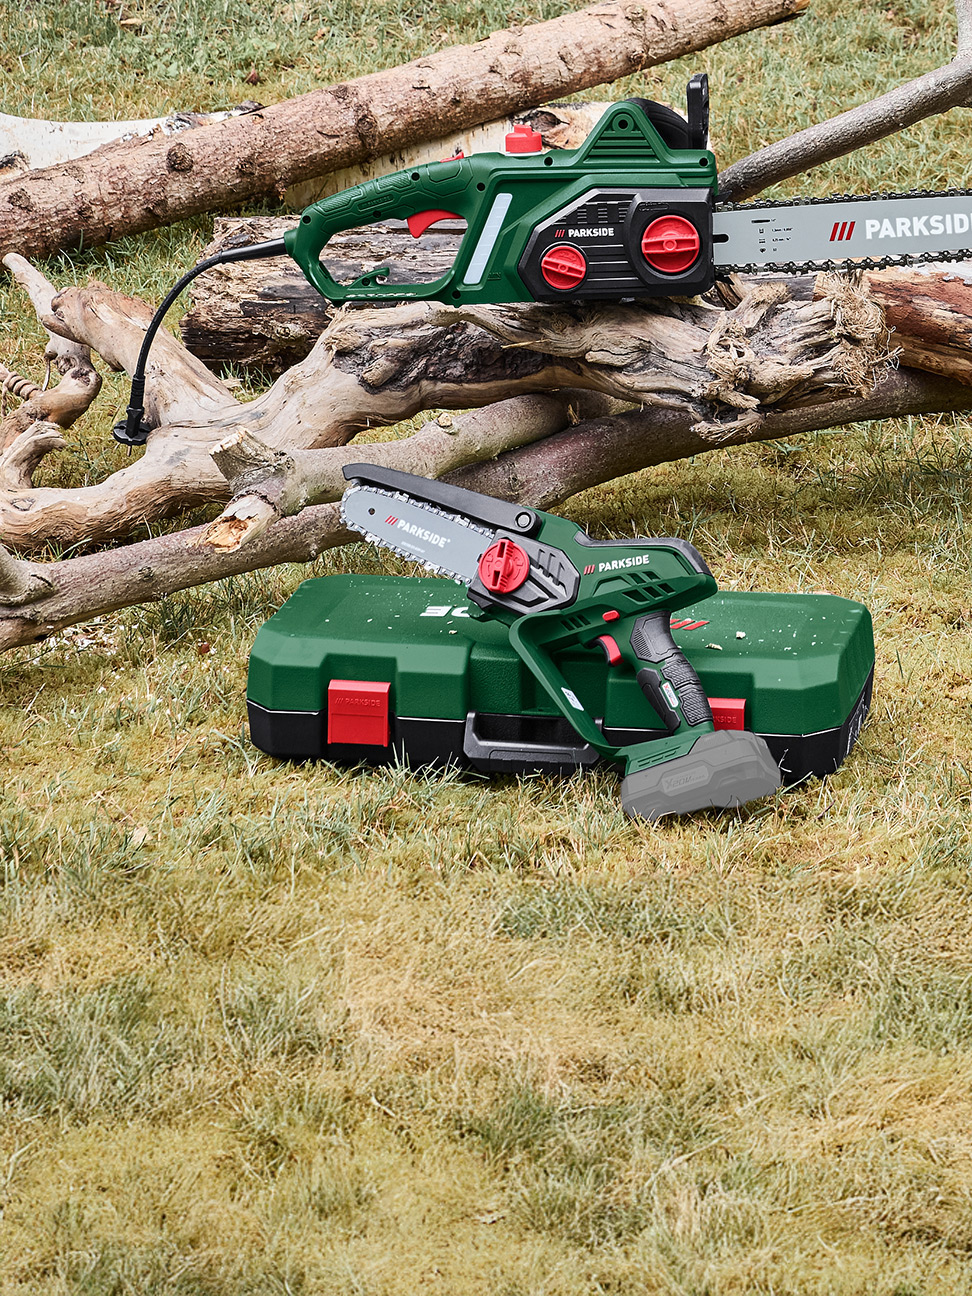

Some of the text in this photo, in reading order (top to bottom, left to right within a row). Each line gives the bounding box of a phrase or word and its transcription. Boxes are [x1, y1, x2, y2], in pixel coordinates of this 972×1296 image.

[568, 227, 615, 237] PARKSIDE
[396, 519, 447, 548] PARKSIDE
[598, 554, 650, 572] PARKSIDE
[345, 697, 381, 707] PARKSIDE
